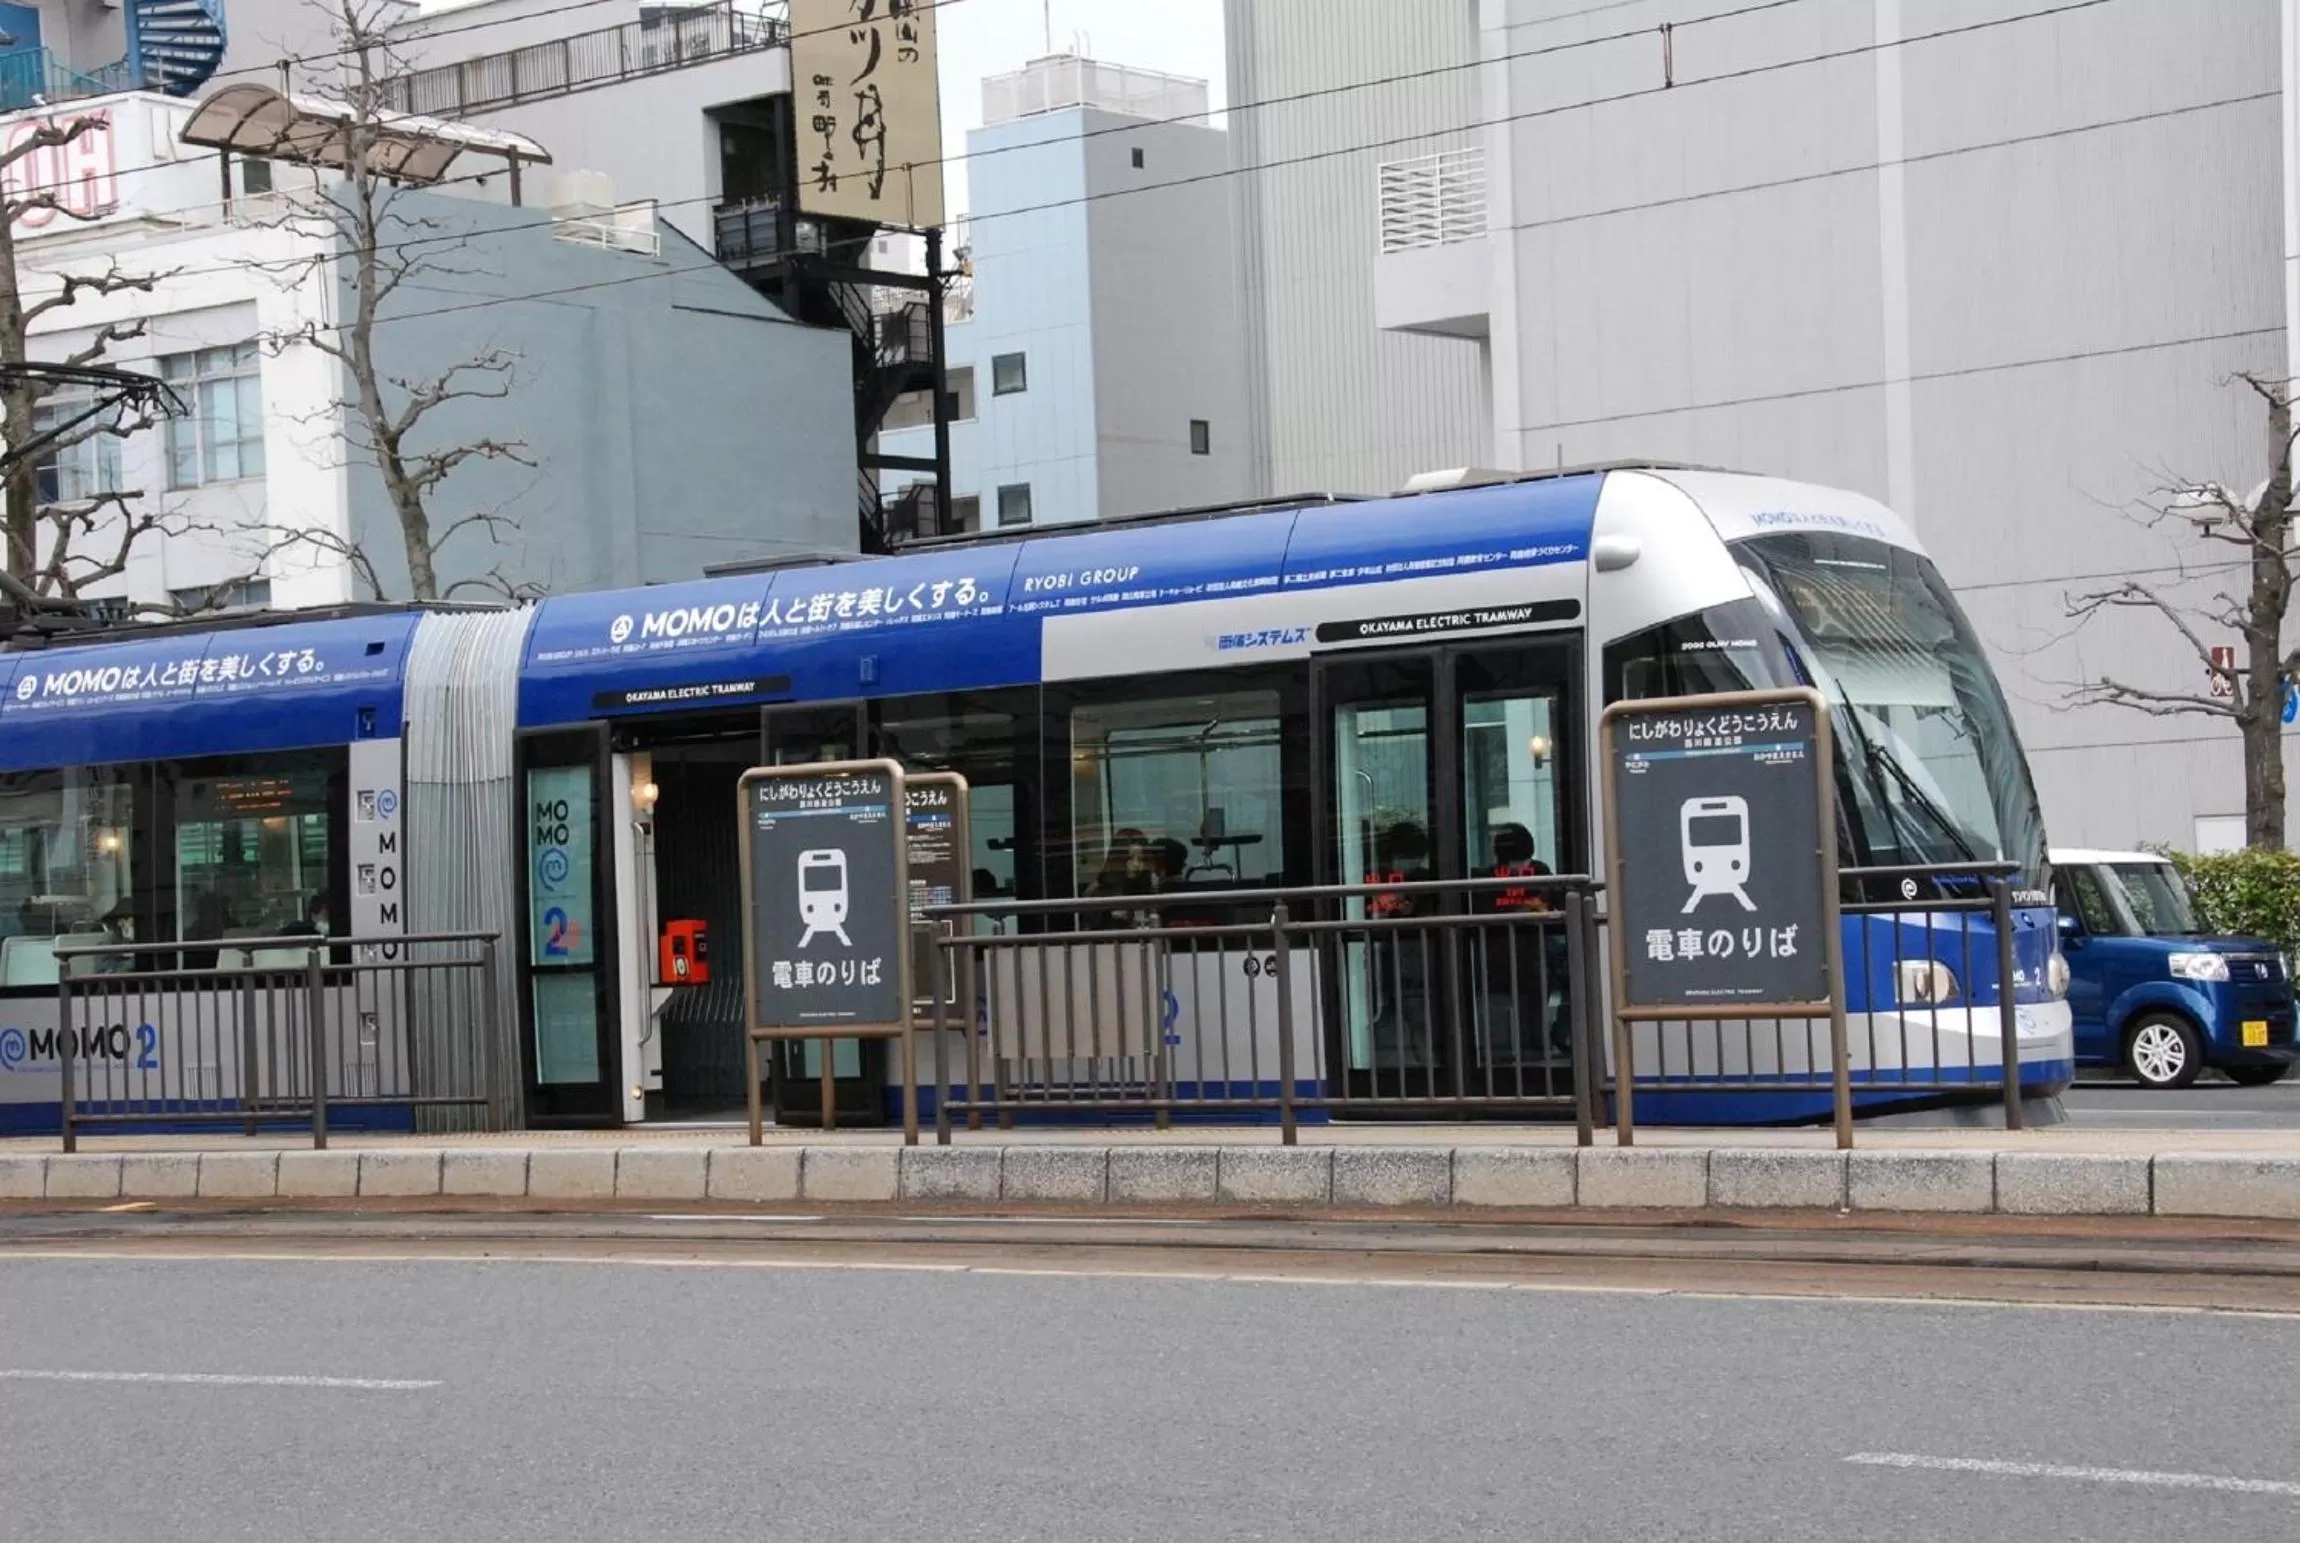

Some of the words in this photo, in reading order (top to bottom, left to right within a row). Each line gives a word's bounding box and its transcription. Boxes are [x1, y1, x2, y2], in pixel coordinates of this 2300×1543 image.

[1024, 572, 1074, 593] RYOBI
[1080, 566, 1140, 586] GROUP
[641, 577, 989, 639] MOMOは人と街を美しくする。
[1359, 619, 1414, 635] OKAYAMA
[1416, 612, 1471, 630] ELECTRIC
[1474, 607, 1533, 624] TRAMWAY
[42, 648, 325, 697] MOMOは人と街を美しくする。
[625, 690, 667, 703] OKAYAMA
[667, 684, 711, 700] ELECTRIC
[711, 681, 756, 695] TRAMWAY
[1628, 711, 1799, 741] にしがわりょくどうこうえん
[759, 779, 882, 802] にしがわりょくどうこうえん
[1645, 923, 1798, 962] 電車のりば
[772, 957, 882, 989] 電車のりば
[136, 1023, 159, 1069] 2
